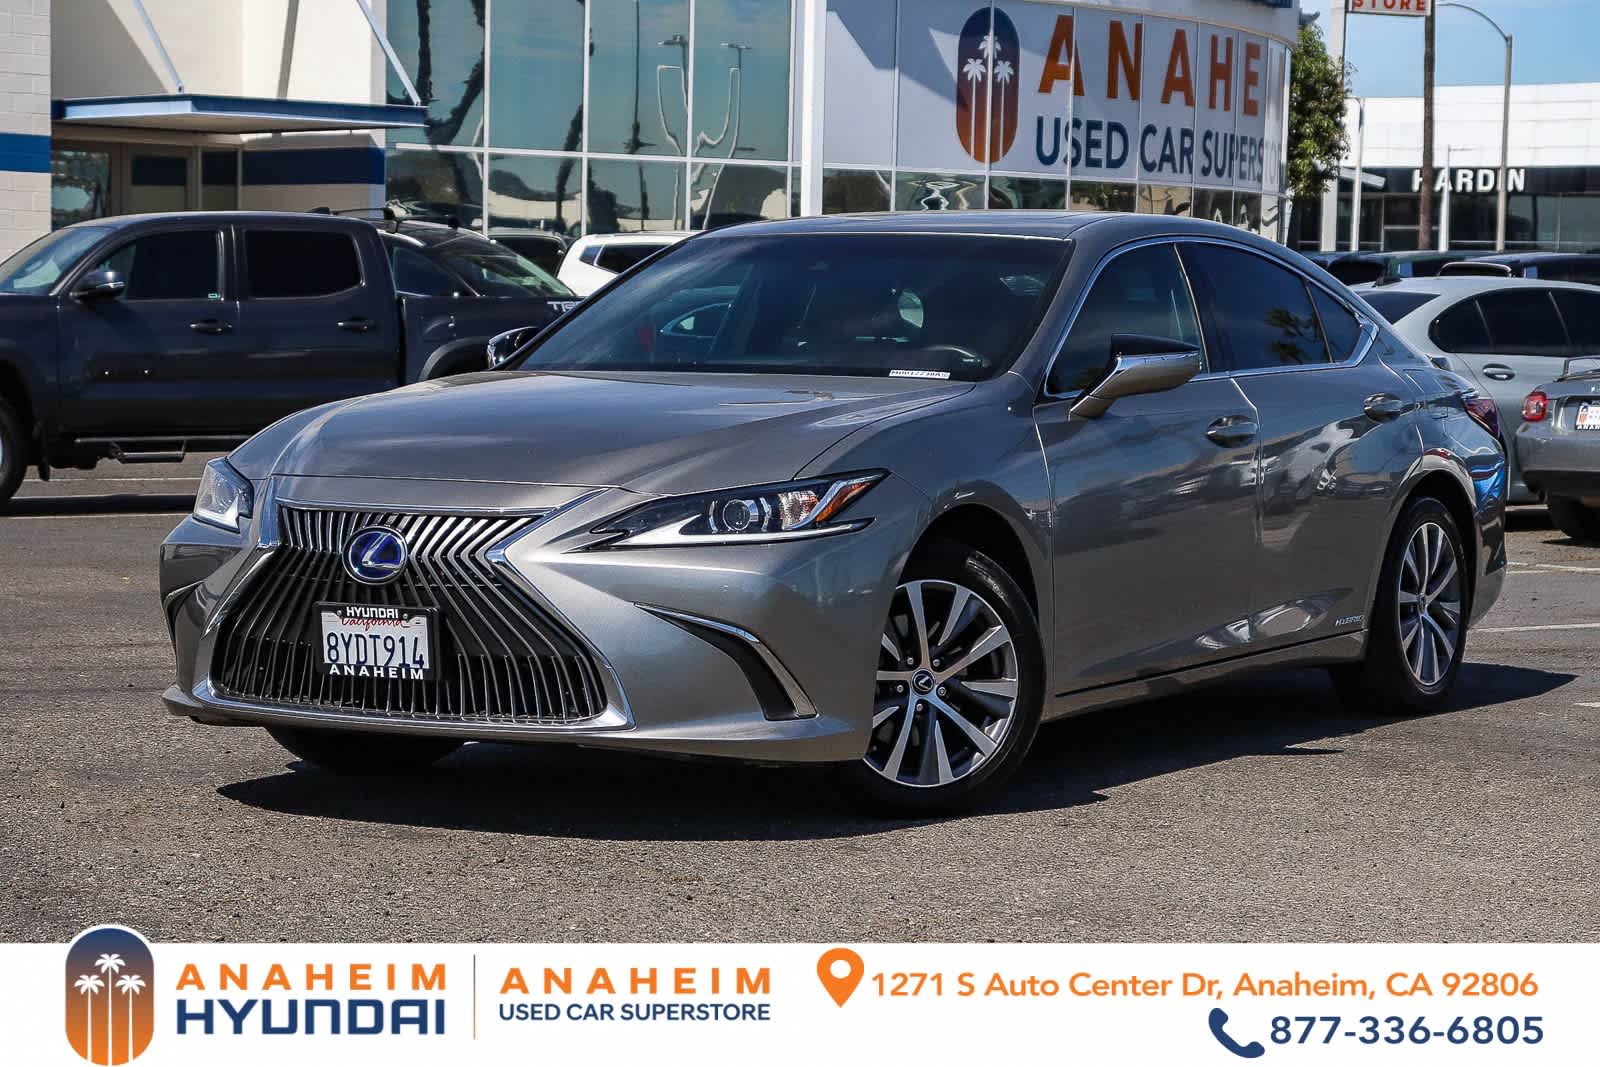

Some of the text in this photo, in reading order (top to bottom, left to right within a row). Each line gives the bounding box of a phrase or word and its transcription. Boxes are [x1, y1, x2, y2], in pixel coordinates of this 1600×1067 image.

[1038, 15, 1285, 117] ANAHE
[1036, 116, 1129, 168] USED
[1140, 123, 1193, 174] CAR
[346, 607, 399, 618] HYUNDAI
[327, 632, 425, 668] 8YDT914
[329, 664, 424, 680] ANAHEIM
